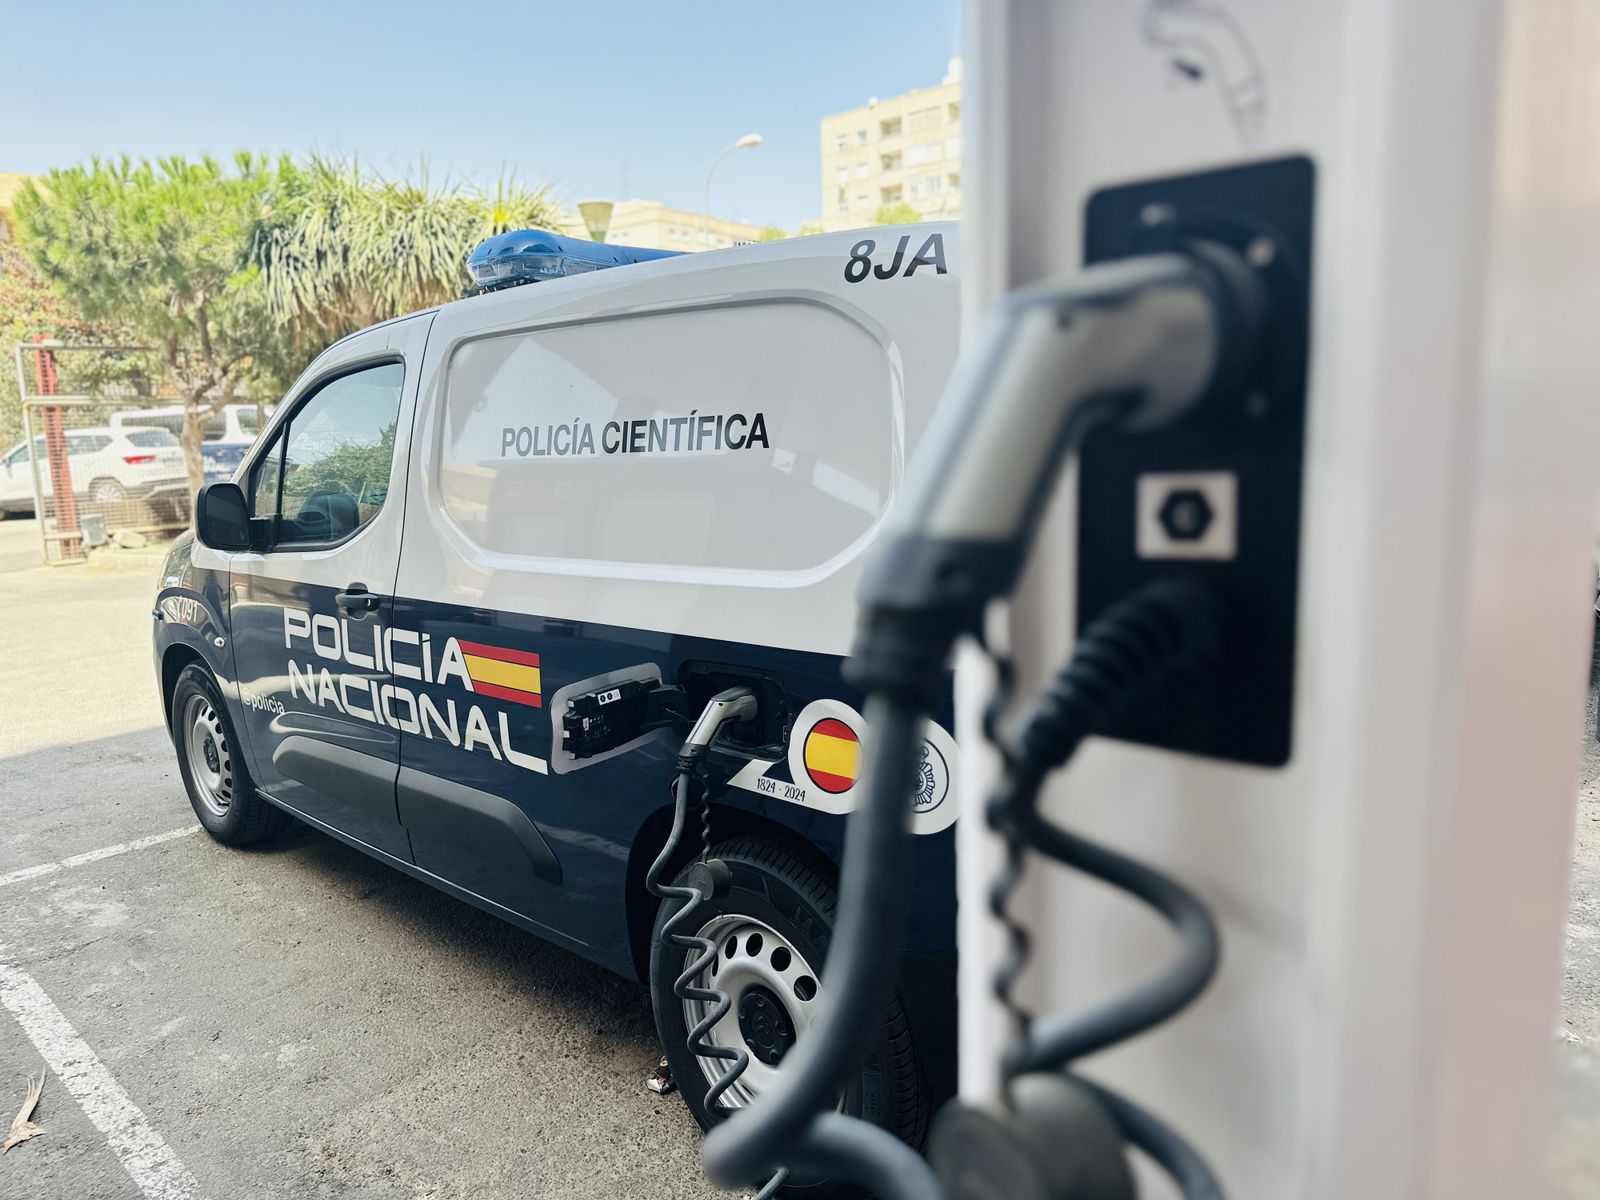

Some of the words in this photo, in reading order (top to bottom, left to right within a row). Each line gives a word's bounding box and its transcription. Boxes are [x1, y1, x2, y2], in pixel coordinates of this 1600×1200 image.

[844, 233, 947, 284] 8JA
[501, 417, 595, 457] POLICÍA
[601, 409, 770, 454] CIENTÍFICA
[283, 607, 475, 692] POLICÍA
[288, 659, 548, 775] NACIONAL
[756, 778, 776, 793] 1824
[784, 785, 806, 802] 2024
